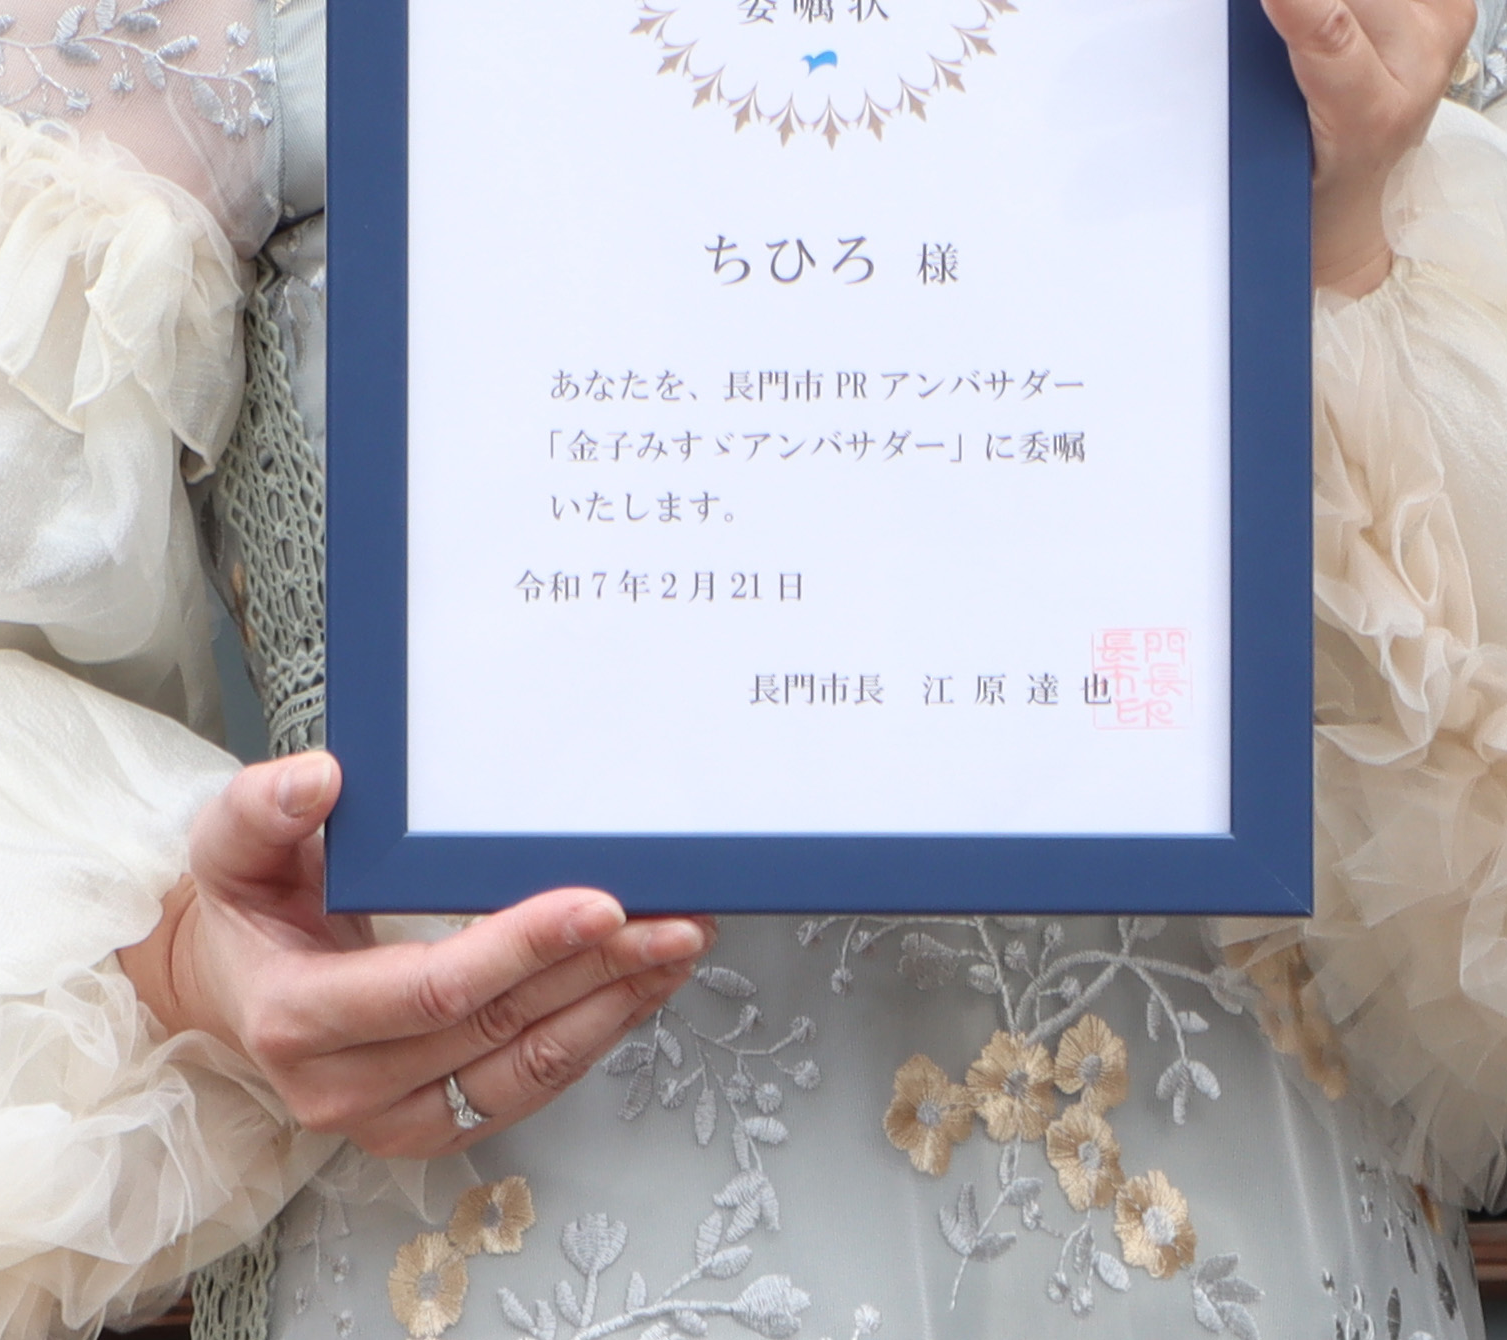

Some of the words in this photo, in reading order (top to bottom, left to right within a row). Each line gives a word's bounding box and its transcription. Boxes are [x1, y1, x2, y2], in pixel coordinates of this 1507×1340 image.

[704, 233, 876, 286] ちひろ
[916, 241, 959, 286] 様
[551, 490, 739, 524] いたします。
[749, 671, 885, 707] 長門市長
